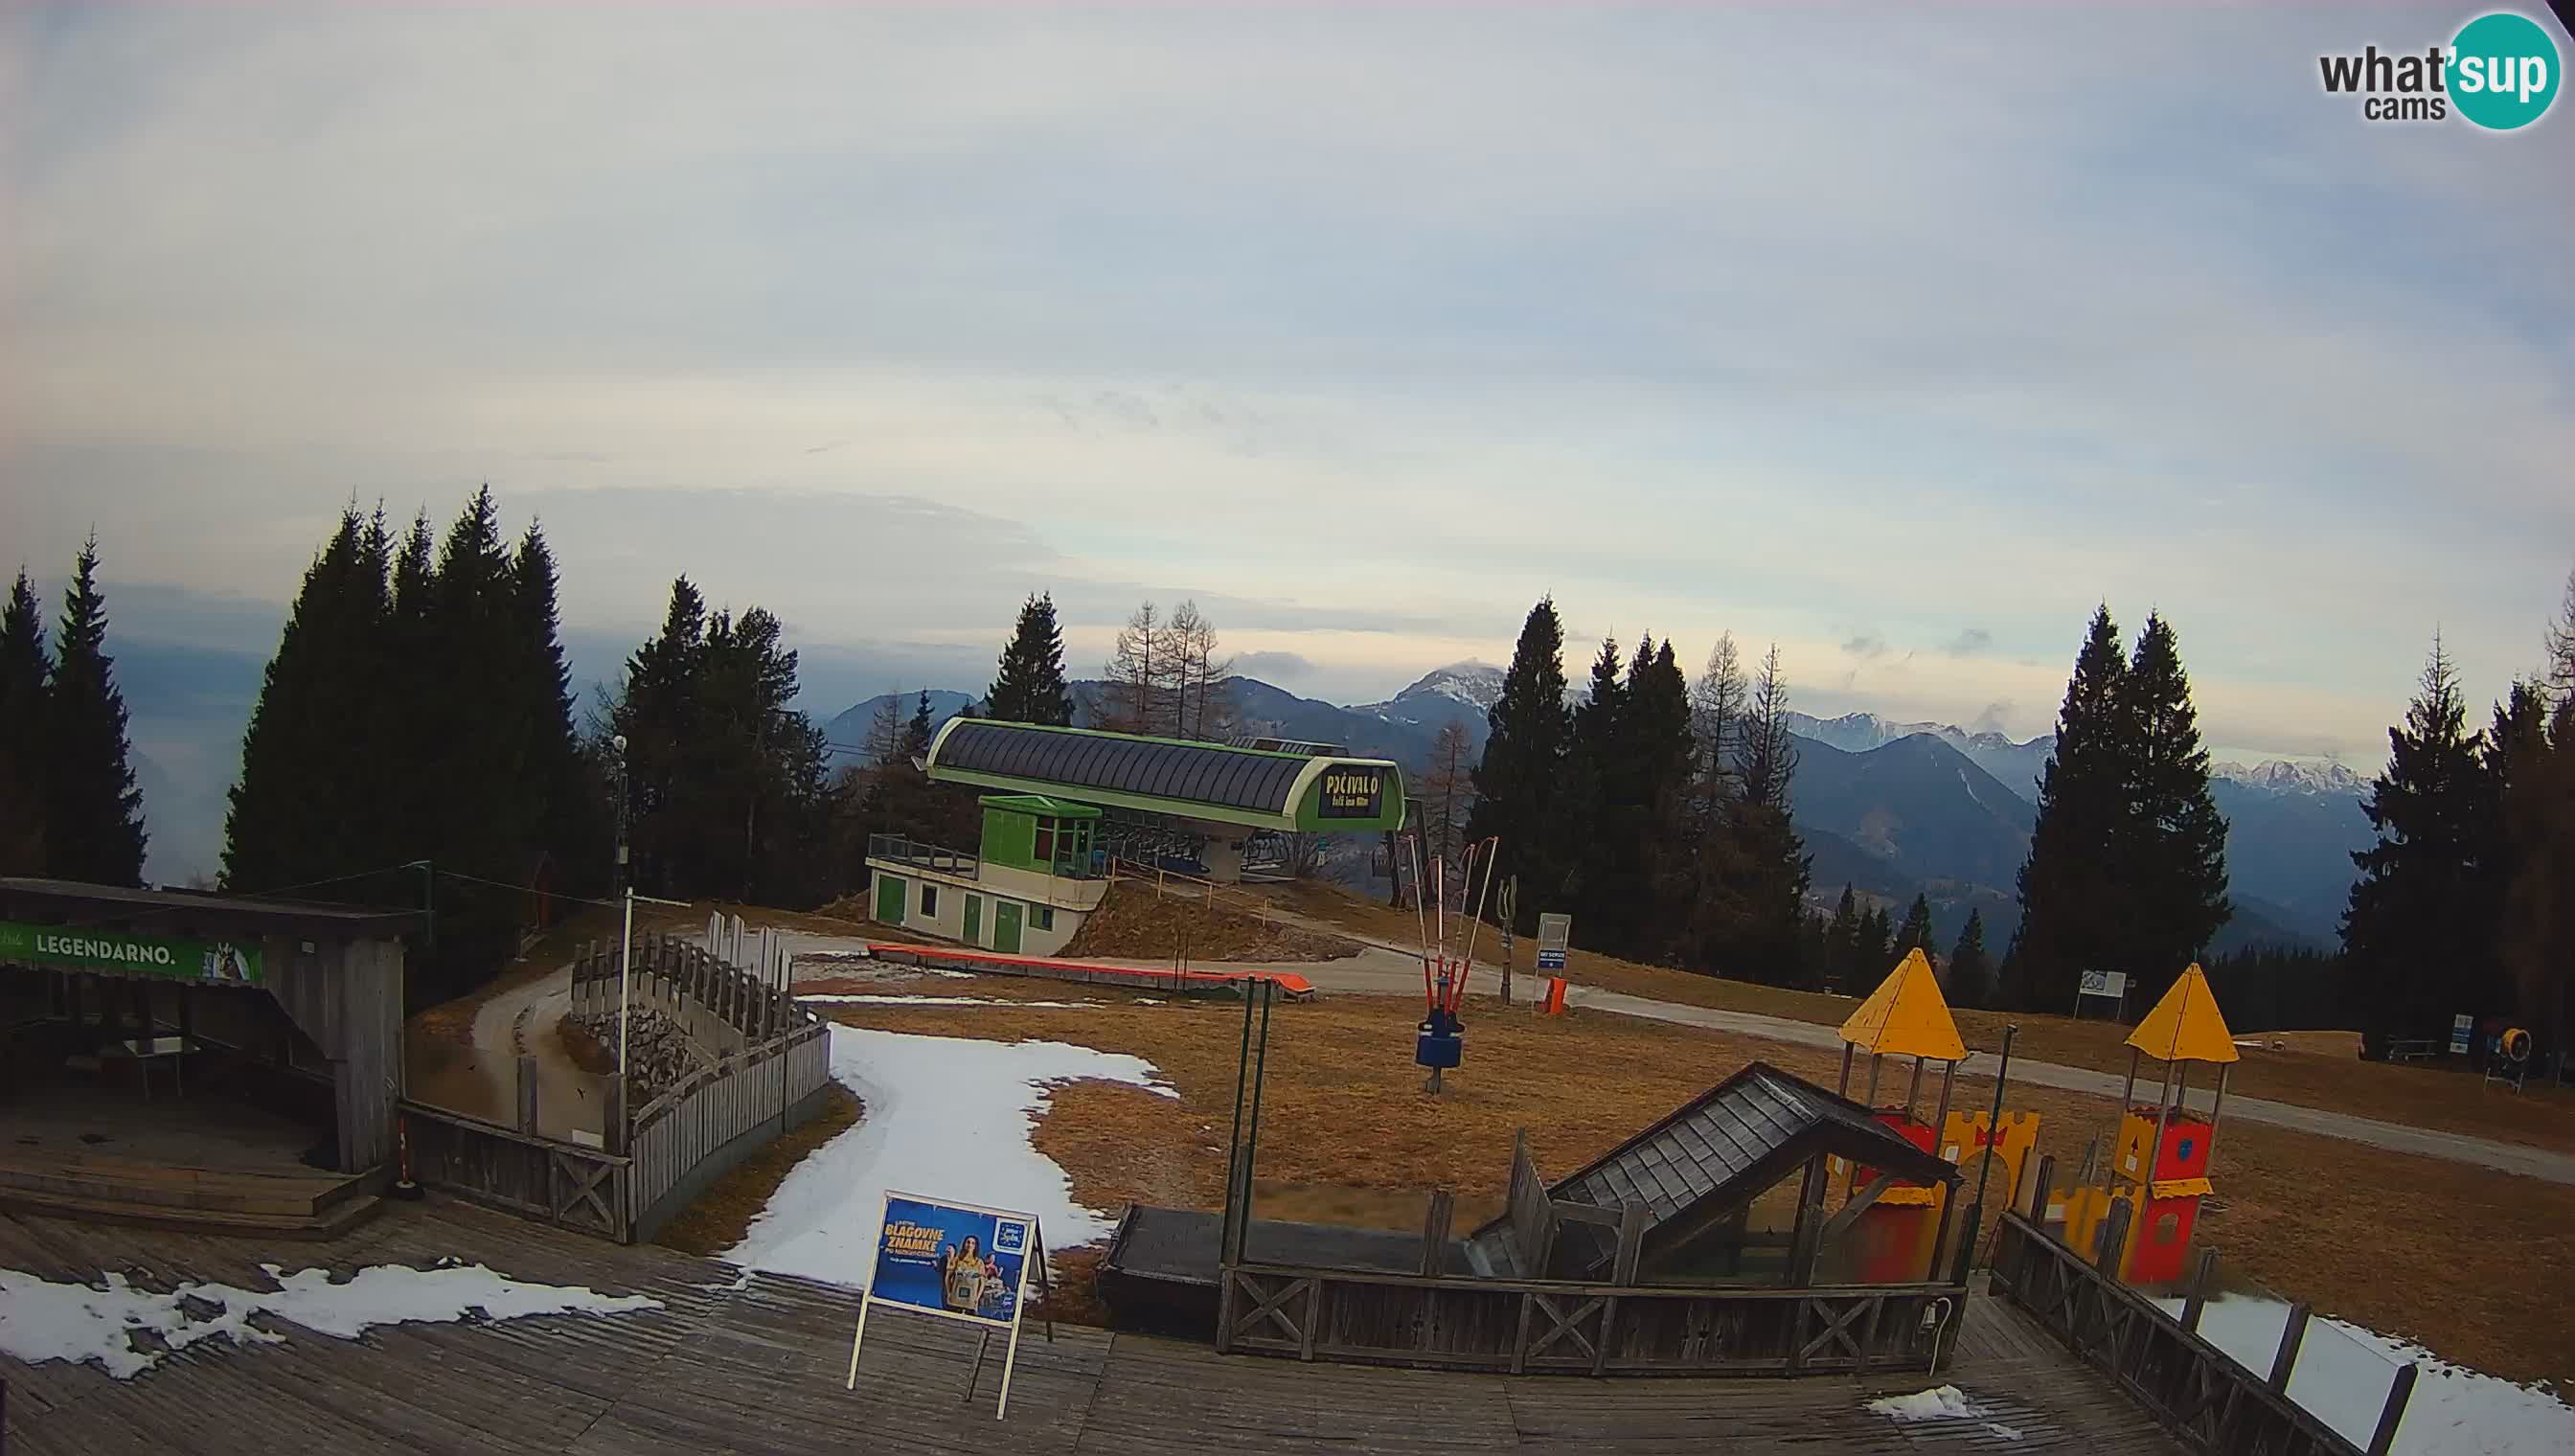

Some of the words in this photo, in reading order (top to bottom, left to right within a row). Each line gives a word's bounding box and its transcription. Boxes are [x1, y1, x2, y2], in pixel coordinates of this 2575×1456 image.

[36, 934, 176, 966] LEGENDARNO.
[885, 1223, 946, 1240] BLAGOVNE
[887, 1236, 939, 1252] ZNAMKE
